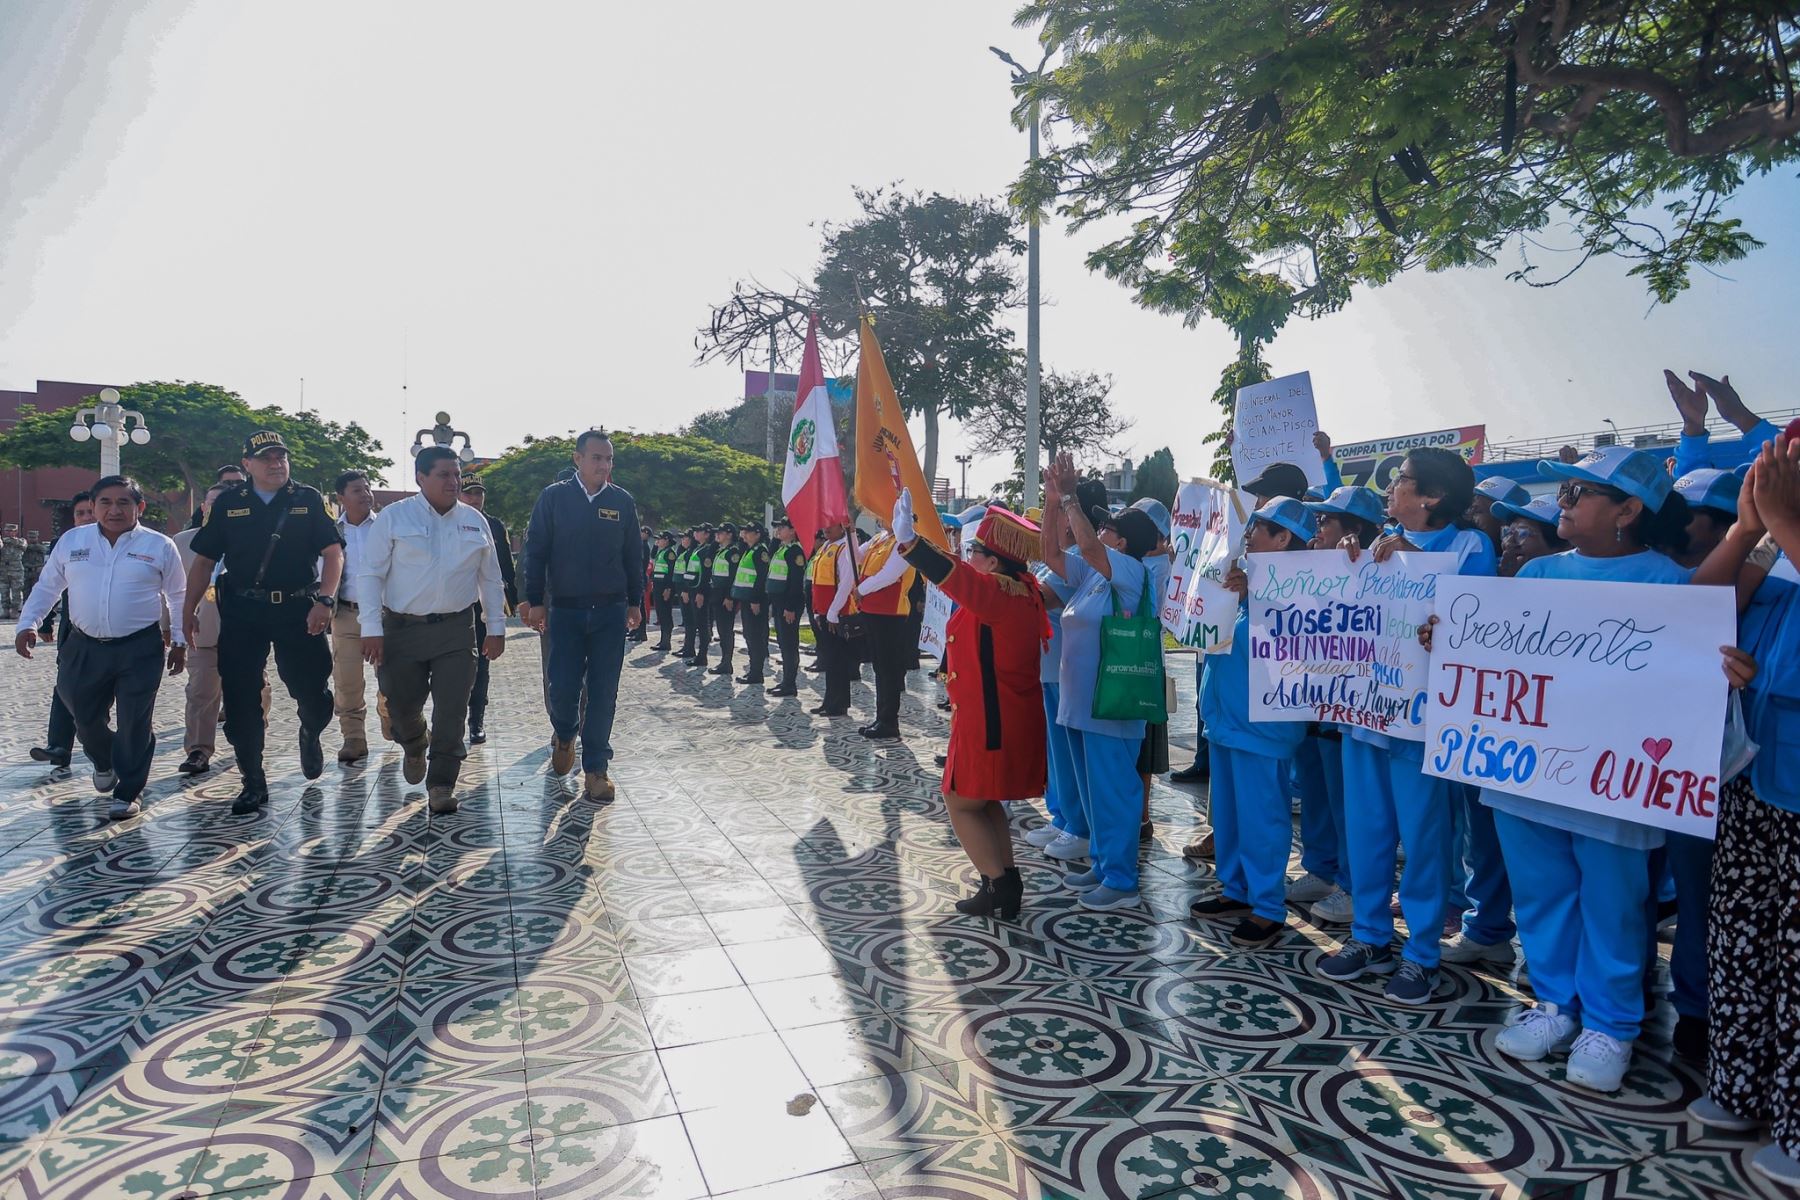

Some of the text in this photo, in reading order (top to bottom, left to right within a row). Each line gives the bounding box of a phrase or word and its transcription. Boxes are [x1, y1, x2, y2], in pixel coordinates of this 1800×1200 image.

[1250, 392, 1280, 408] INTEGRAL
[1288, 387, 1307, 397] DEL
[1267, 408, 1294, 419] MAYOR
[1335, 433, 1455, 459] COMPRA TU CASA POR
[1255, 564, 1350, 601] Señor
[1448, 592, 1667, 672] Presidente
[1252, 636, 1271, 659] la
[1274, 635, 1377, 662] BIENVENIDA
[1356, 662, 1371, 678] DE
[1438, 663, 1554, 728] JERI
